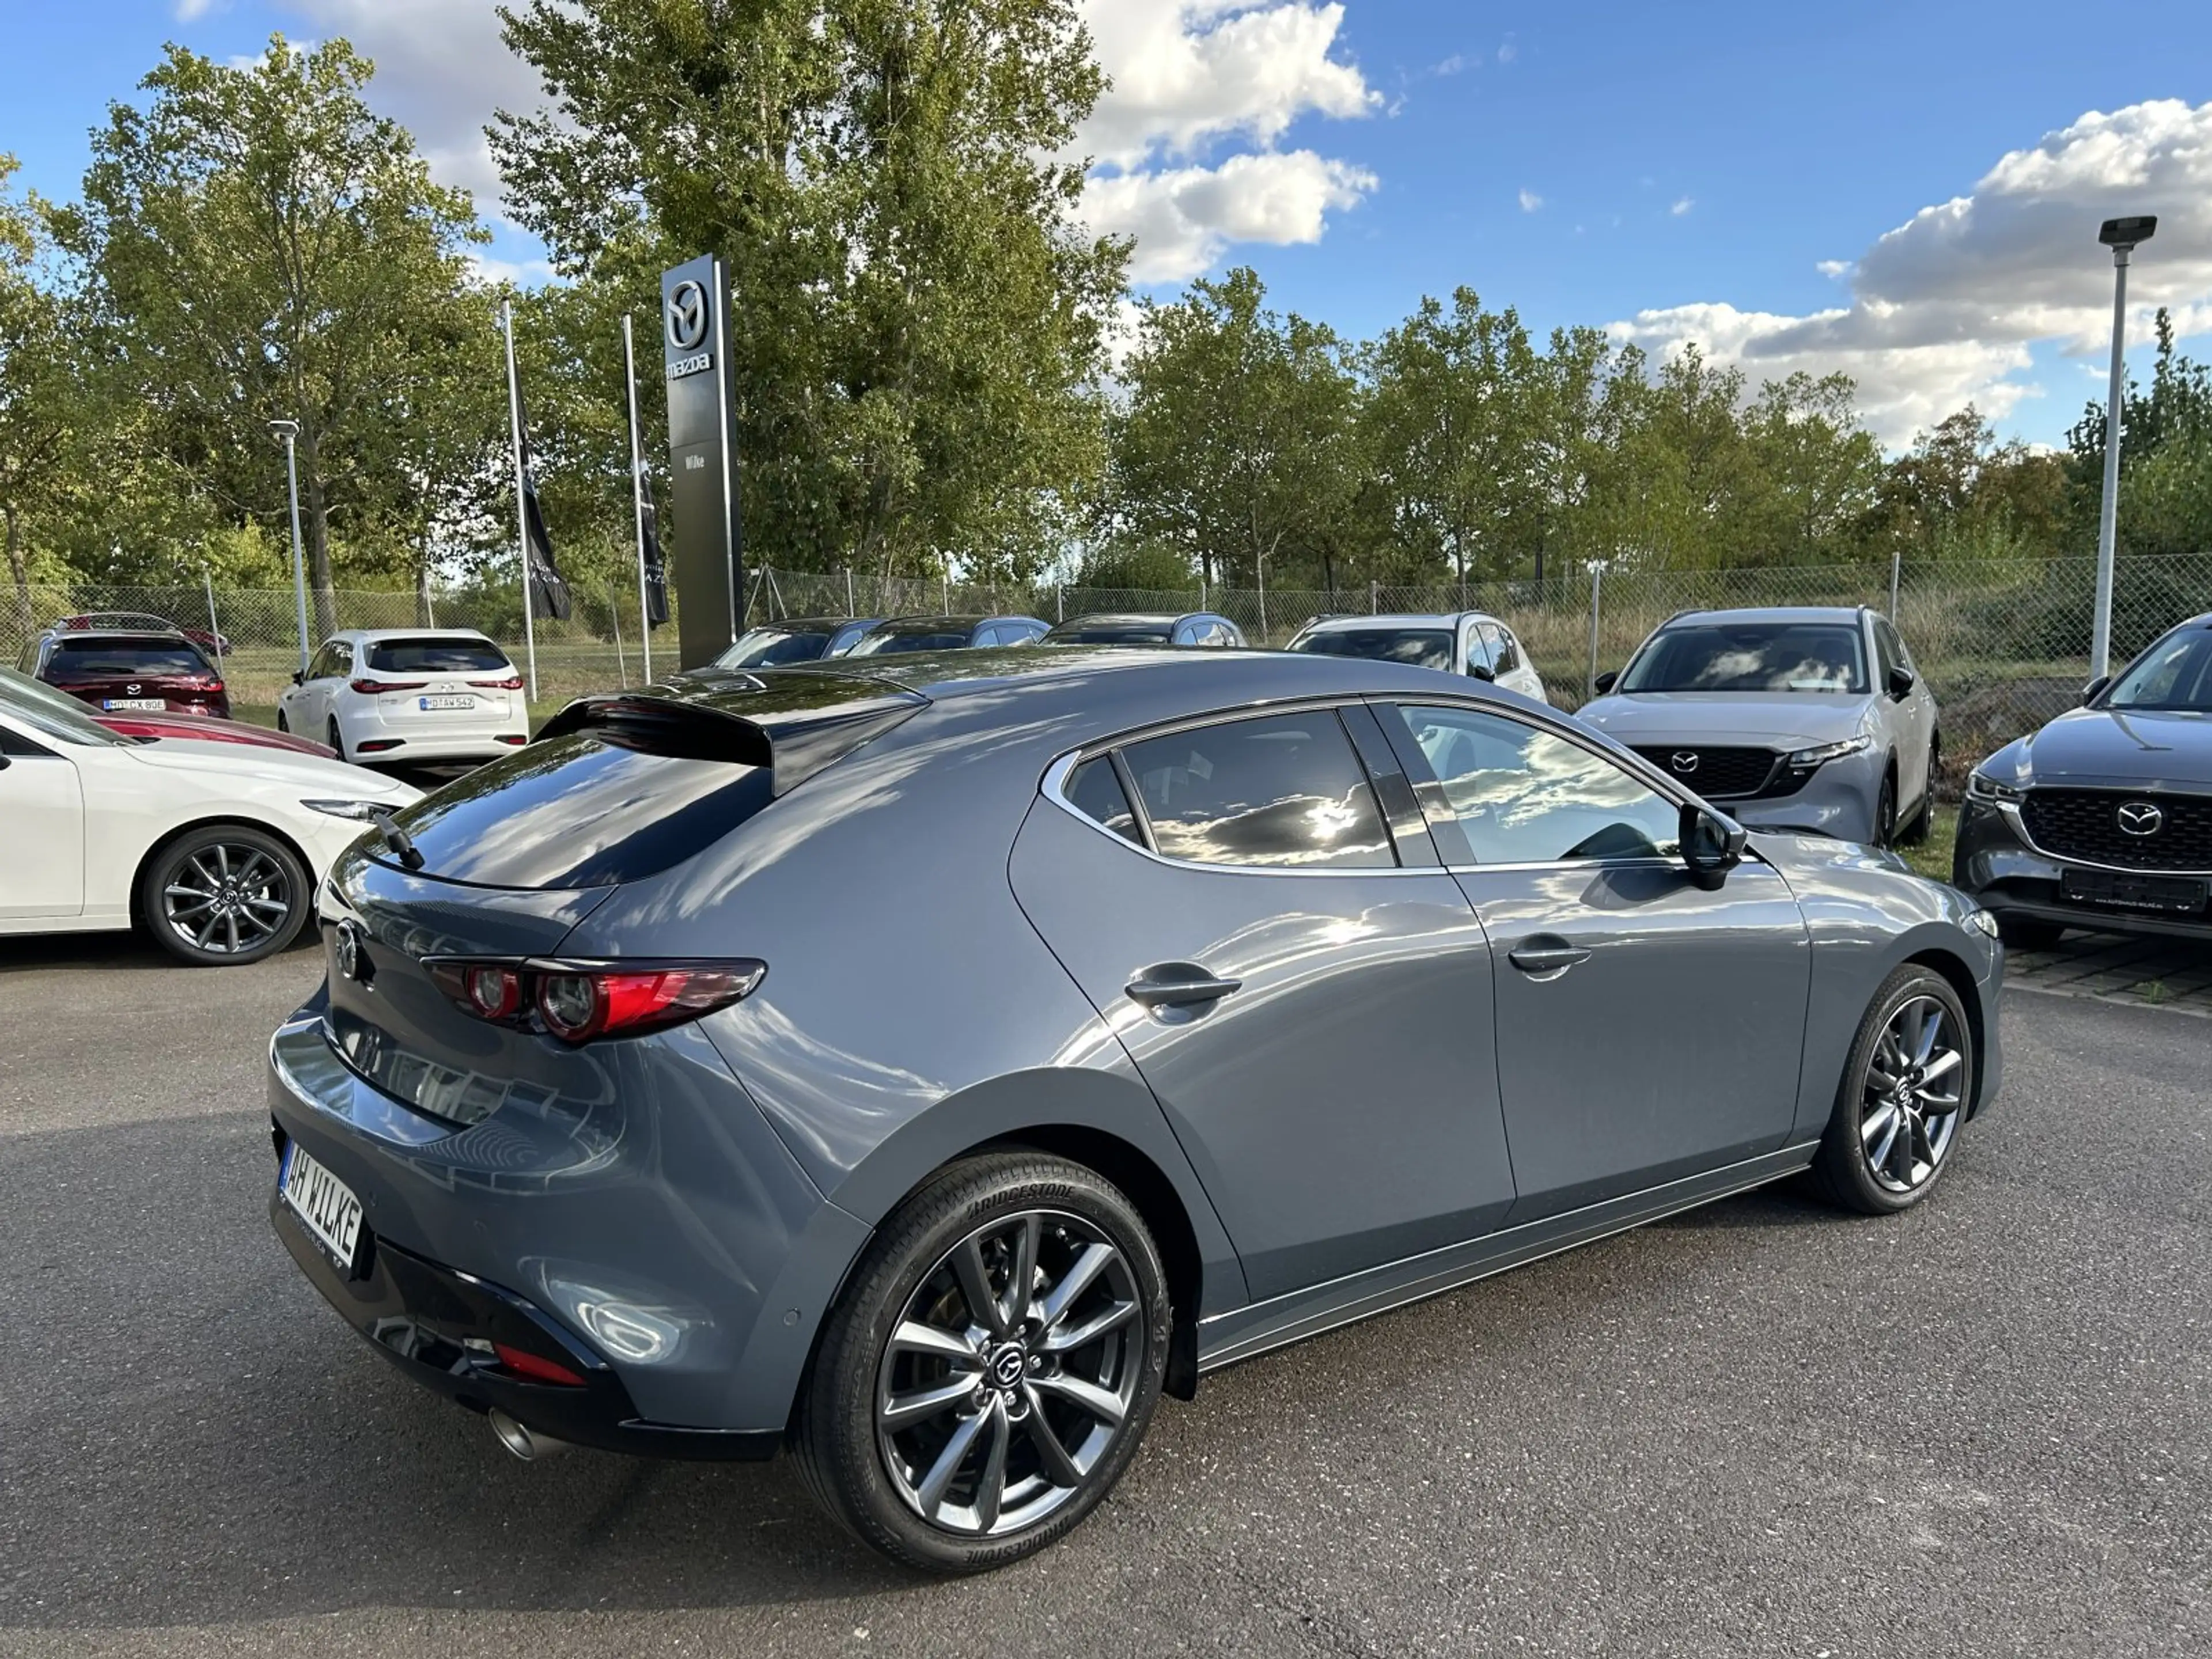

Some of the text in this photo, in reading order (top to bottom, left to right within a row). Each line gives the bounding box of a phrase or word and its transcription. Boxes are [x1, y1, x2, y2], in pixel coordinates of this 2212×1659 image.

[130, 700, 143, 710] CX
[456, 698, 472, 706] 542
[287, 1146, 310, 1203] AH
[306, 1166, 361, 1257] WILKE
[967, 1183, 1076, 1221] BRIDGESTONE
